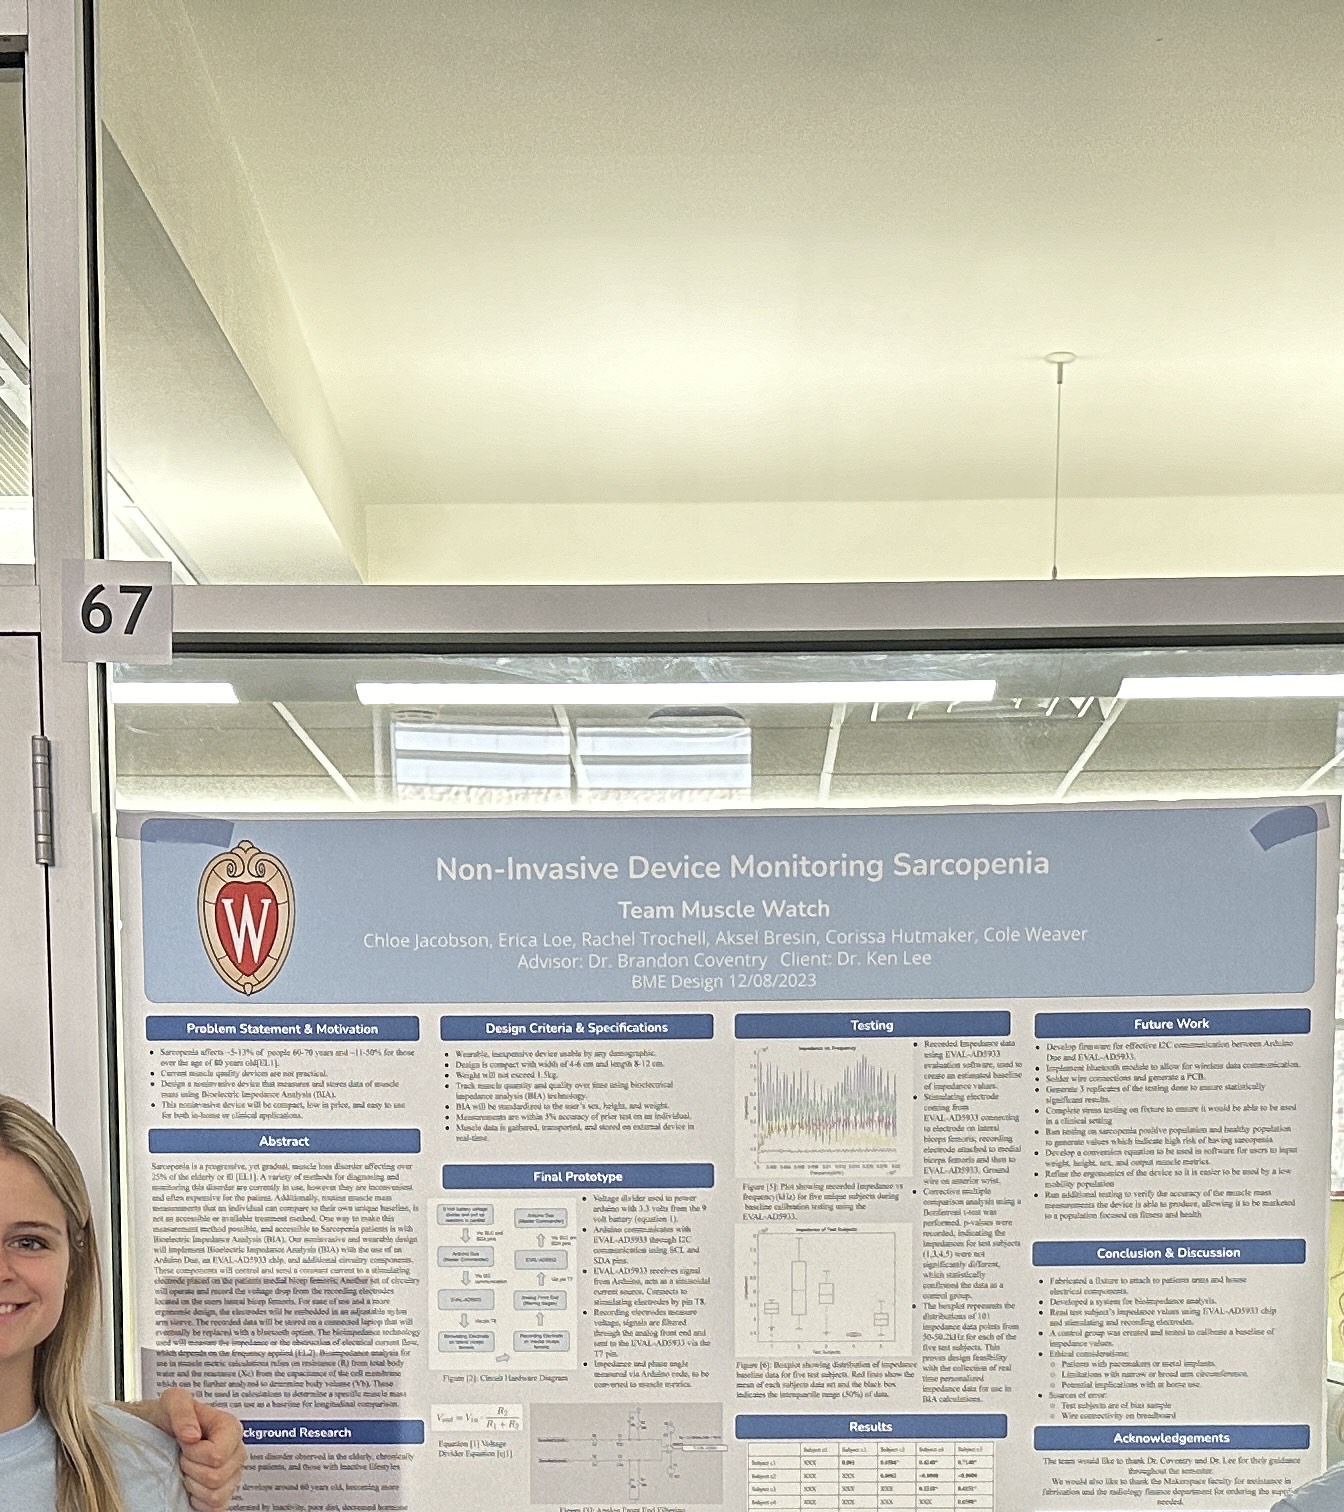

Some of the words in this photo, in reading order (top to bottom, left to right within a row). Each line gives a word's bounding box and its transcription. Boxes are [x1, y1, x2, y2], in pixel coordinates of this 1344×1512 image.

[81, 584, 153, 635] 67
[436, 856, 619, 880] Non-Invasive
[629, 854, 721, 879] Device
[731, 852, 883, 881] Monitoring
[894, 850, 1051, 880] Sarcopenia
[618, 901, 674, 918] Team
[682, 900, 754, 918] Muscle
[762, 899, 830, 917] Watch
[222, 893, 272, 963] W
[362, 933, 412, 947] Chloe
[412, 932, 494, 950] Jacobson,
[496, 932, 538, 946] Erica
[543, 932, 578, 948] Loe,
[582, 931, 635, 945] Rachel
[643, 930, 711, 947] Trochell,
[716, 930, 758, 944] Aksel
[764, 930, 823, 946] Bresin,
[826, 929, 885, 943] Corissa
[892, 928, 978, 945] Hutmaker,
[984, 928, 1020, 942] Cole
[1025, 928, 1088, 942] Weaver
[517, 953, 584, 968] Advisor:
[588, 954, 614, 967] Dr.
[618, 952, 688, 967] Brandon
[694, 952, 767, 971] Coventry
[780, 951, 832, 966] Client:
[838, 952, 862, 965] Dr.
[867, 952, 897, 965] Ken
[903, 951, 931, 965] Lee
[632, 976, 666, 988] BME
[671, 974, 723, 992] Design
[729, 974, 816, 987] 12/08/2023
[187, 1024, 236, 1033] Problem
[240, 1024, 301, 1033] Statement
[304, 1024, 312, 1033] &
[316, 1024, 378, 1033] Motivation
[486, 1023, 526, 1035] Design
[530, 1023, 572, 1032] Criteria
[576, 1023, 584, 1032] &
[588, 1023, 668, 1035] Specifications
[853, 1020, 893, 1032] Testing
[1134, 1019, 1173, 1029] Future
[1177, 1018, 1209, 1028] Work
[260, 1136, 309, 1146] Abstract
[534, 1171, 562, 1181] Final
[566, 1172, 622, 1183] Prototype
[1097, 1248, 1161, 1258] Conclusion
[1165, 1247, 1174, 1257] &
[1178, 1247, 1240, 1257] Discussion
[850, 1422, 892, 1431] Results
[243, 1427, 296, 1439] ckground
[300, 1427, 351, 1437] Research
[1114, 1433, 1230, 1445] Acknowledgements
